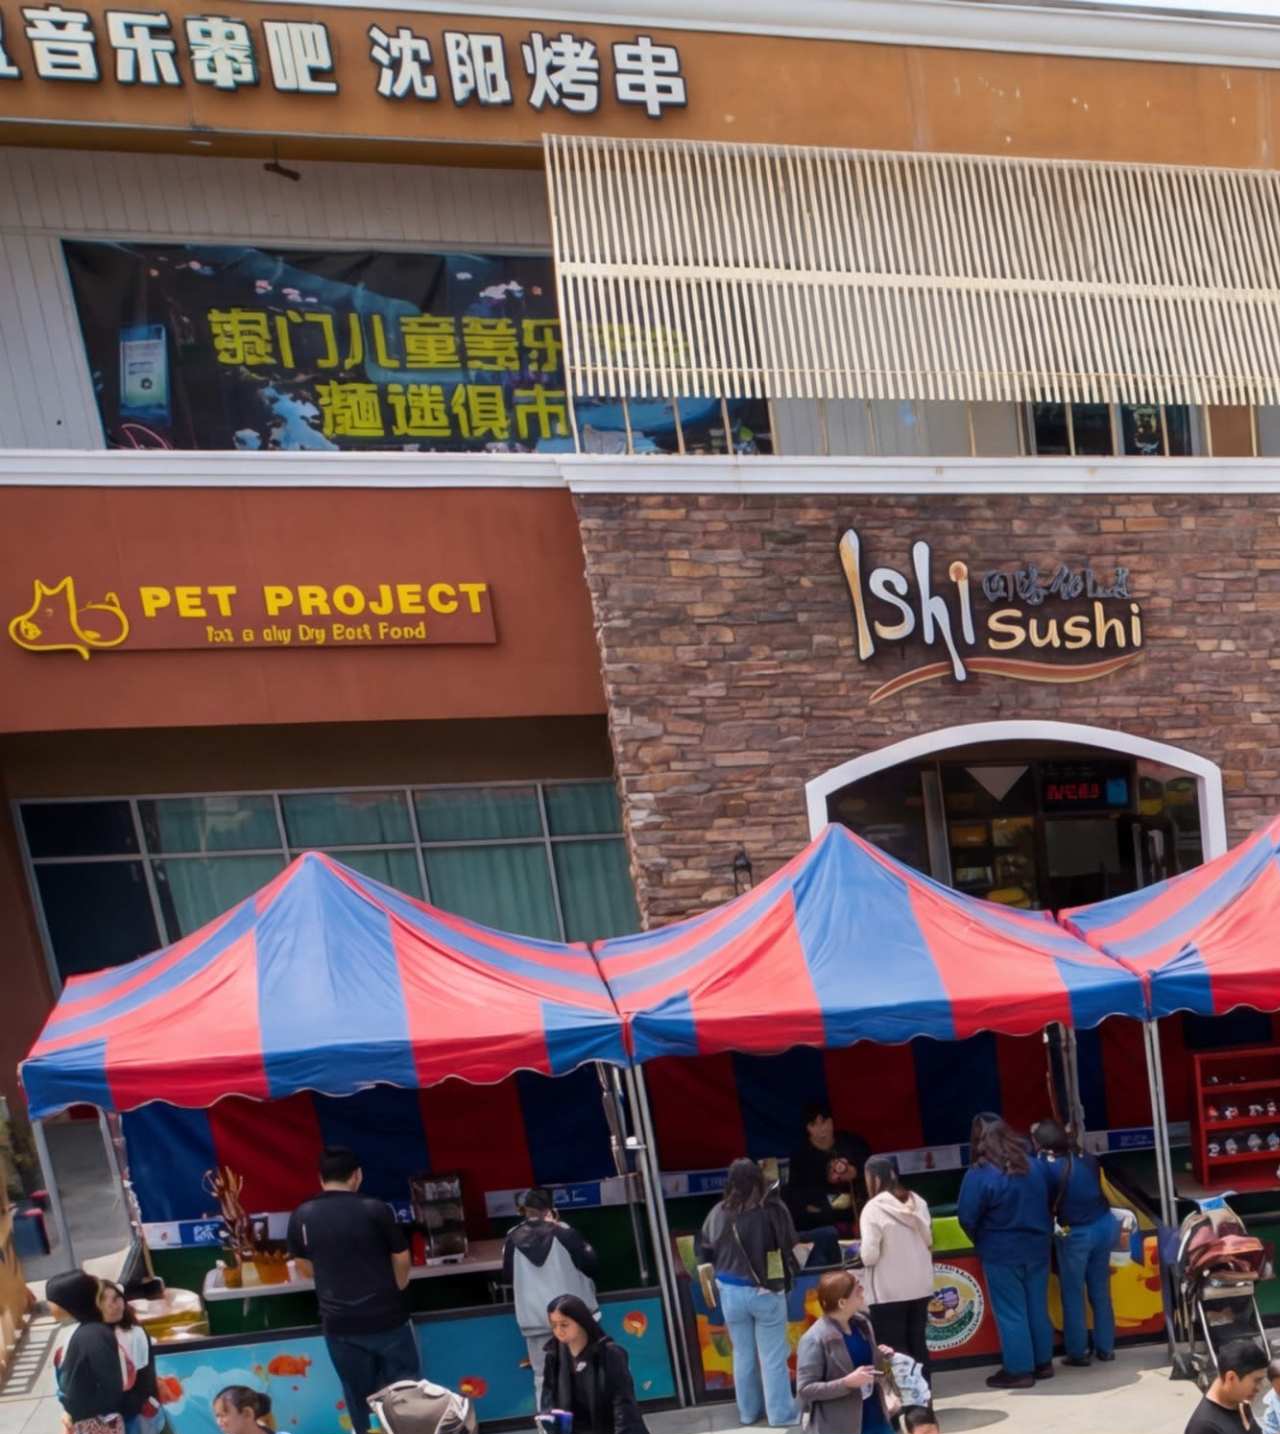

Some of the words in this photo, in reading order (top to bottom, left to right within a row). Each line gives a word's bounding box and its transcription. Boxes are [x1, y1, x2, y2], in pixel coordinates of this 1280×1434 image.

[139, 585, 237, 618] PET
[263, 583, 487, 616] PROJECT
[839, 528, 976, 682] Ishi
[986, 601, 1143, 651] Sushi
